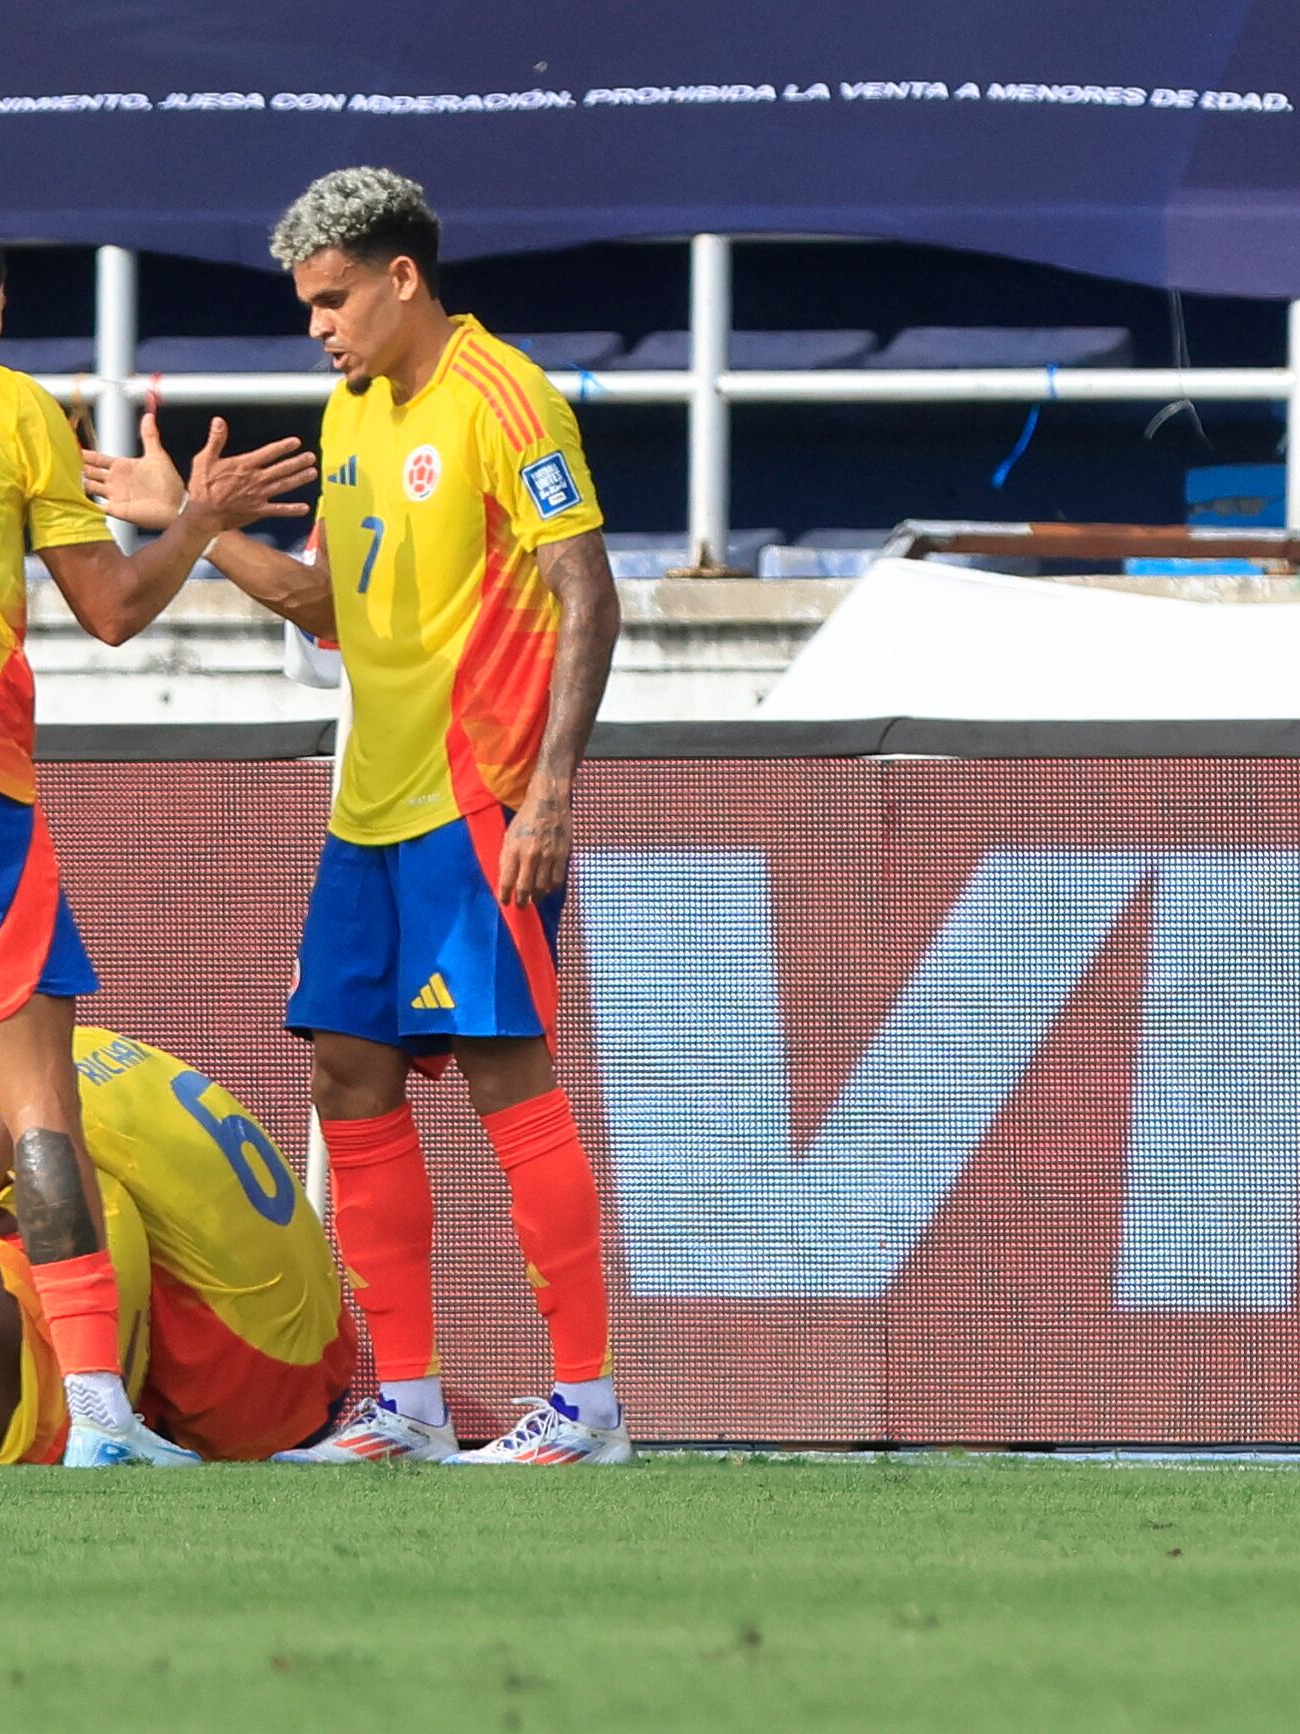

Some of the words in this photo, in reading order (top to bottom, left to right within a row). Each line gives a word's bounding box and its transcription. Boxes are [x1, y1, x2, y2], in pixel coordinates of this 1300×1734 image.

[155, 92, 265, 112] JUEGA
[269, 92, 345, 112] CON
[582, 84, 776, 107] PROHIBIDA
[779, 83, 831, 103] LA
[837, 81, 950, 103] VENTA
[952, 81, 982, 101] A
[984, 82, 1149, 107] MENORES
[1149, 88, 1200, 110] DE
[357, 516, 384, 594] 7
[170, 1070, 296, 1227] 6
